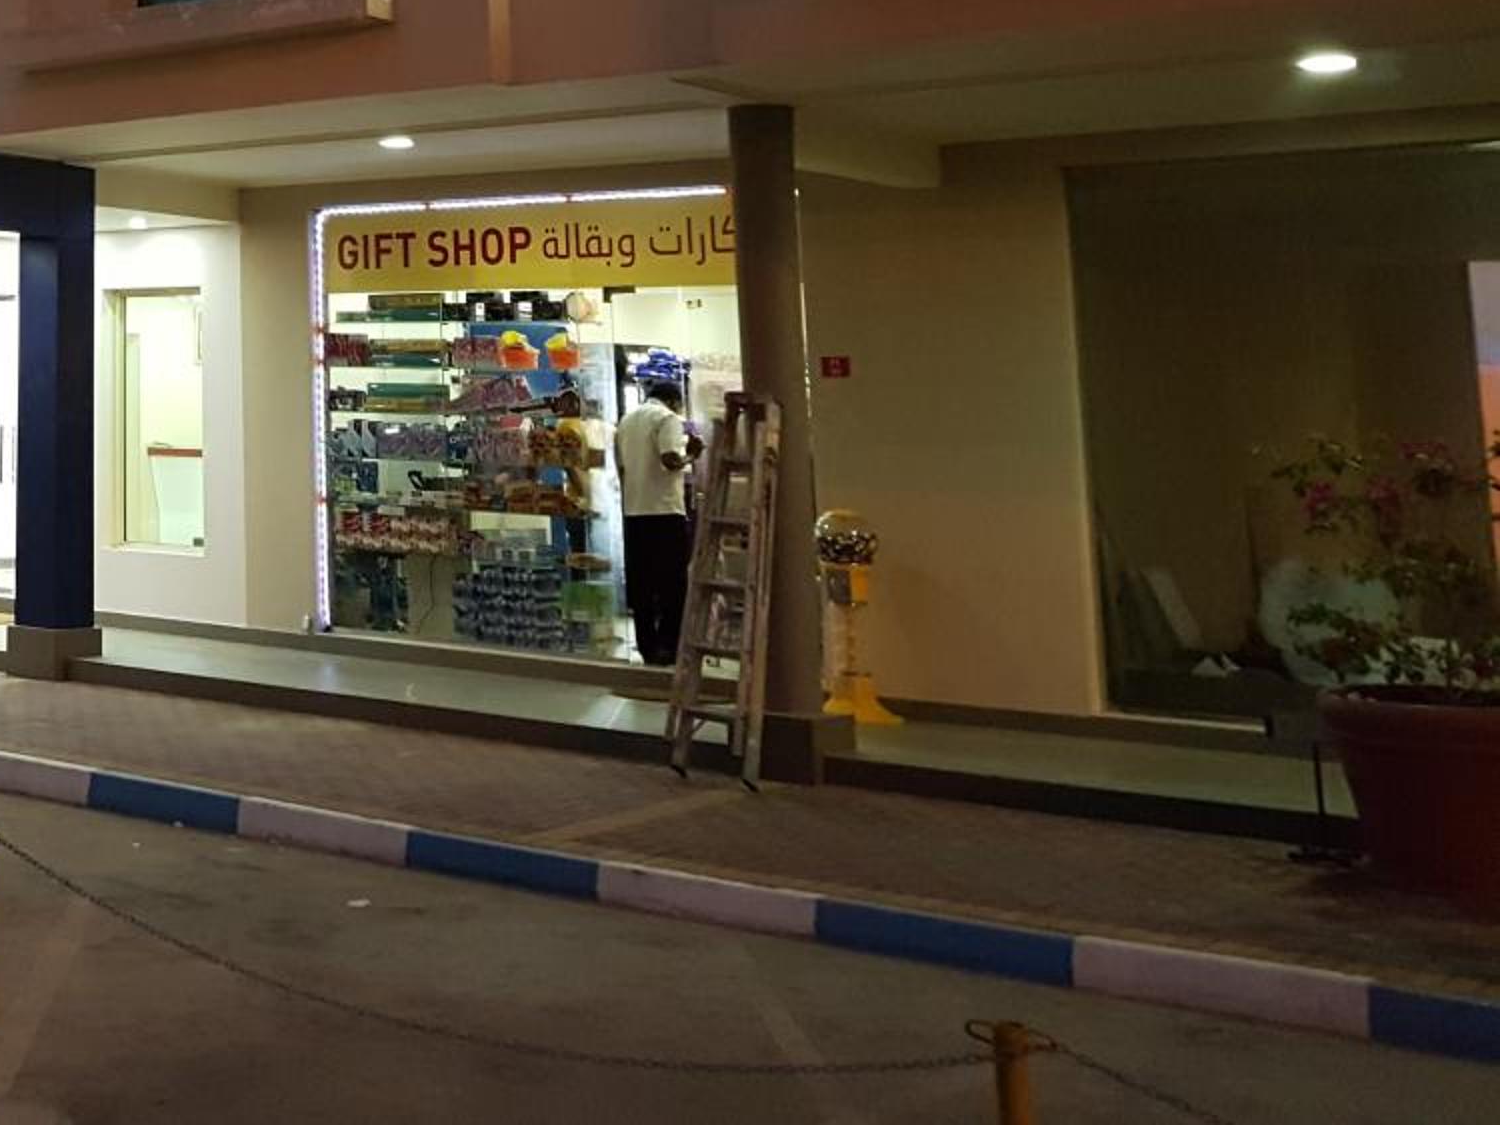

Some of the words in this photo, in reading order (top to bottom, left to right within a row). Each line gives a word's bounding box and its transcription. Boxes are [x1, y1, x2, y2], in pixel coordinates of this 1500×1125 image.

[337, 232, 417, 270] GIFT
[427, 225, 532, 268] SHOP
[543, 222, 636, 268] وبقالة
[649, 215, 736, 266] كارات
